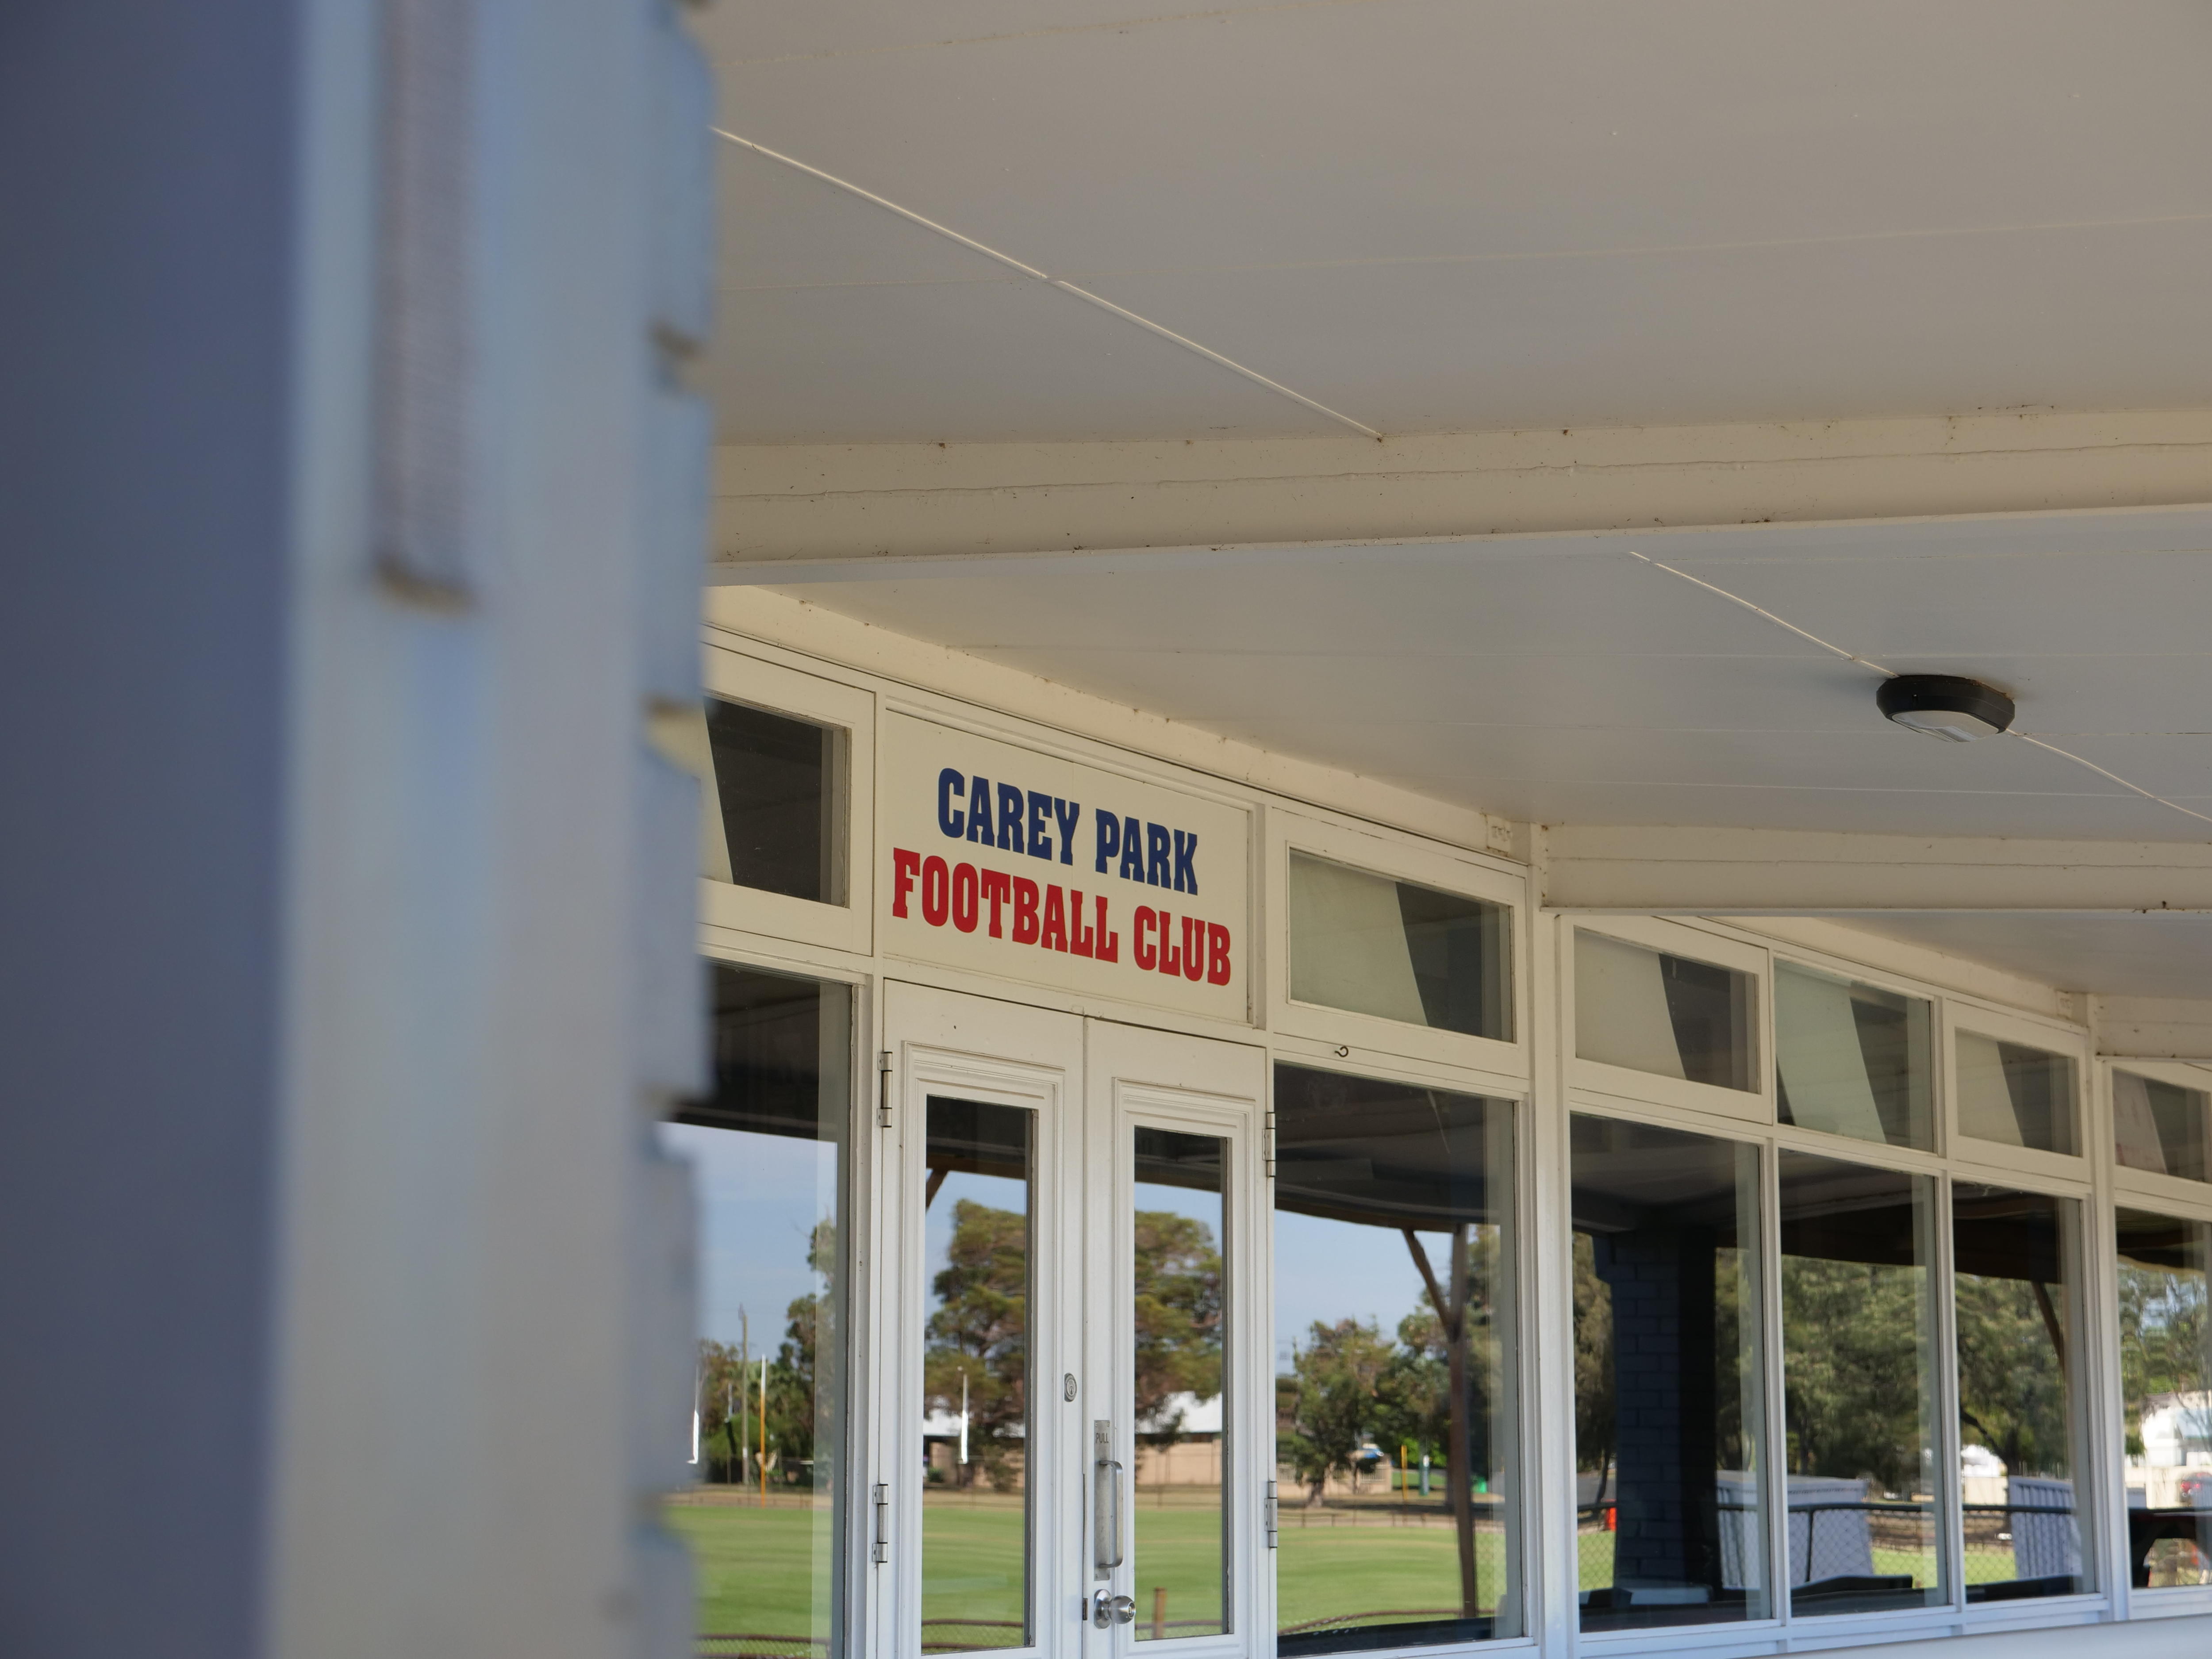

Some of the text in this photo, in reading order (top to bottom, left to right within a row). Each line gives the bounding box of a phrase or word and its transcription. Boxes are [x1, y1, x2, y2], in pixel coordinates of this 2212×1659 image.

[938, 768, 1198, 895] CAREY PARK
[892, 847, 1231, 986] FOOTBALL CLUB
[1095, 1432, 1109, 1443] PULL
